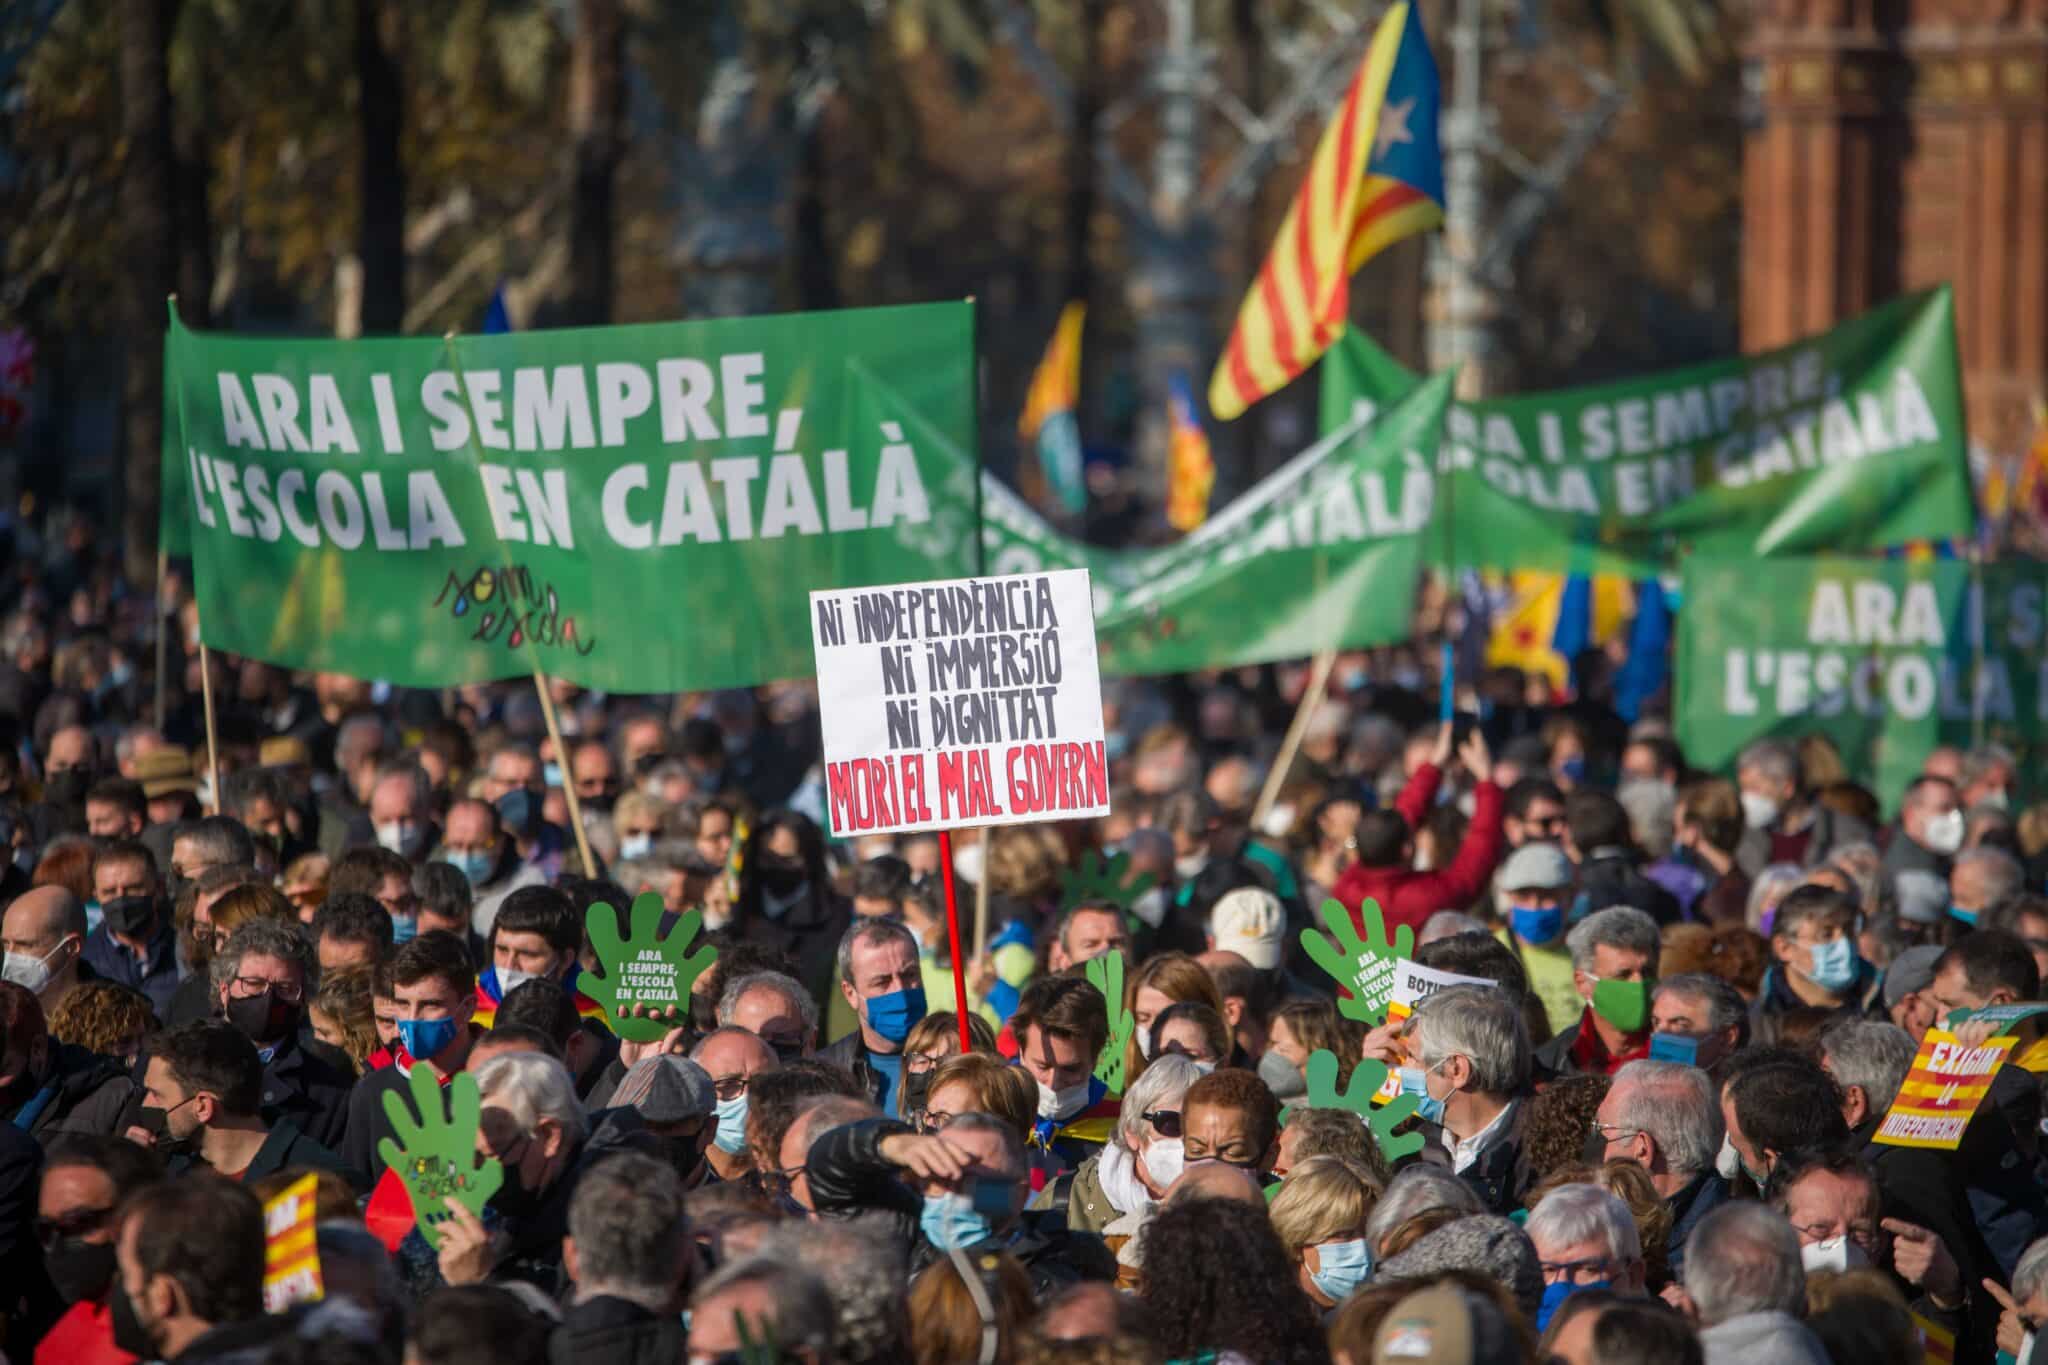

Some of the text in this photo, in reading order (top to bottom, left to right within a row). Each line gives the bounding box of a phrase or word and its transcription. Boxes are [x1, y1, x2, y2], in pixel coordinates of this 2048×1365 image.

[217, 372, 360, 453] ARA
[370, 373, 404, 453] I
[1538, 412, 1565, 463] I
[189, 447, 466, 550] L'ESCOLA
[470, 463, 573, 550] EN
[1807, 579, 1945, 645] ARA
[1724, 647, 2016, 721] L'ESCOLA
[900, 753, 932, 824] EL
[936, 749, 1003, 820] MAL
[1006, 740, 1108, 815] GOVERN
[619, 962, 679, 976] I SEMPRE,
[621, 976, 675, 987] L'ESCOLA
[637, 950, 662, 961] ARA
[616, 988, 632, 1000] EN
